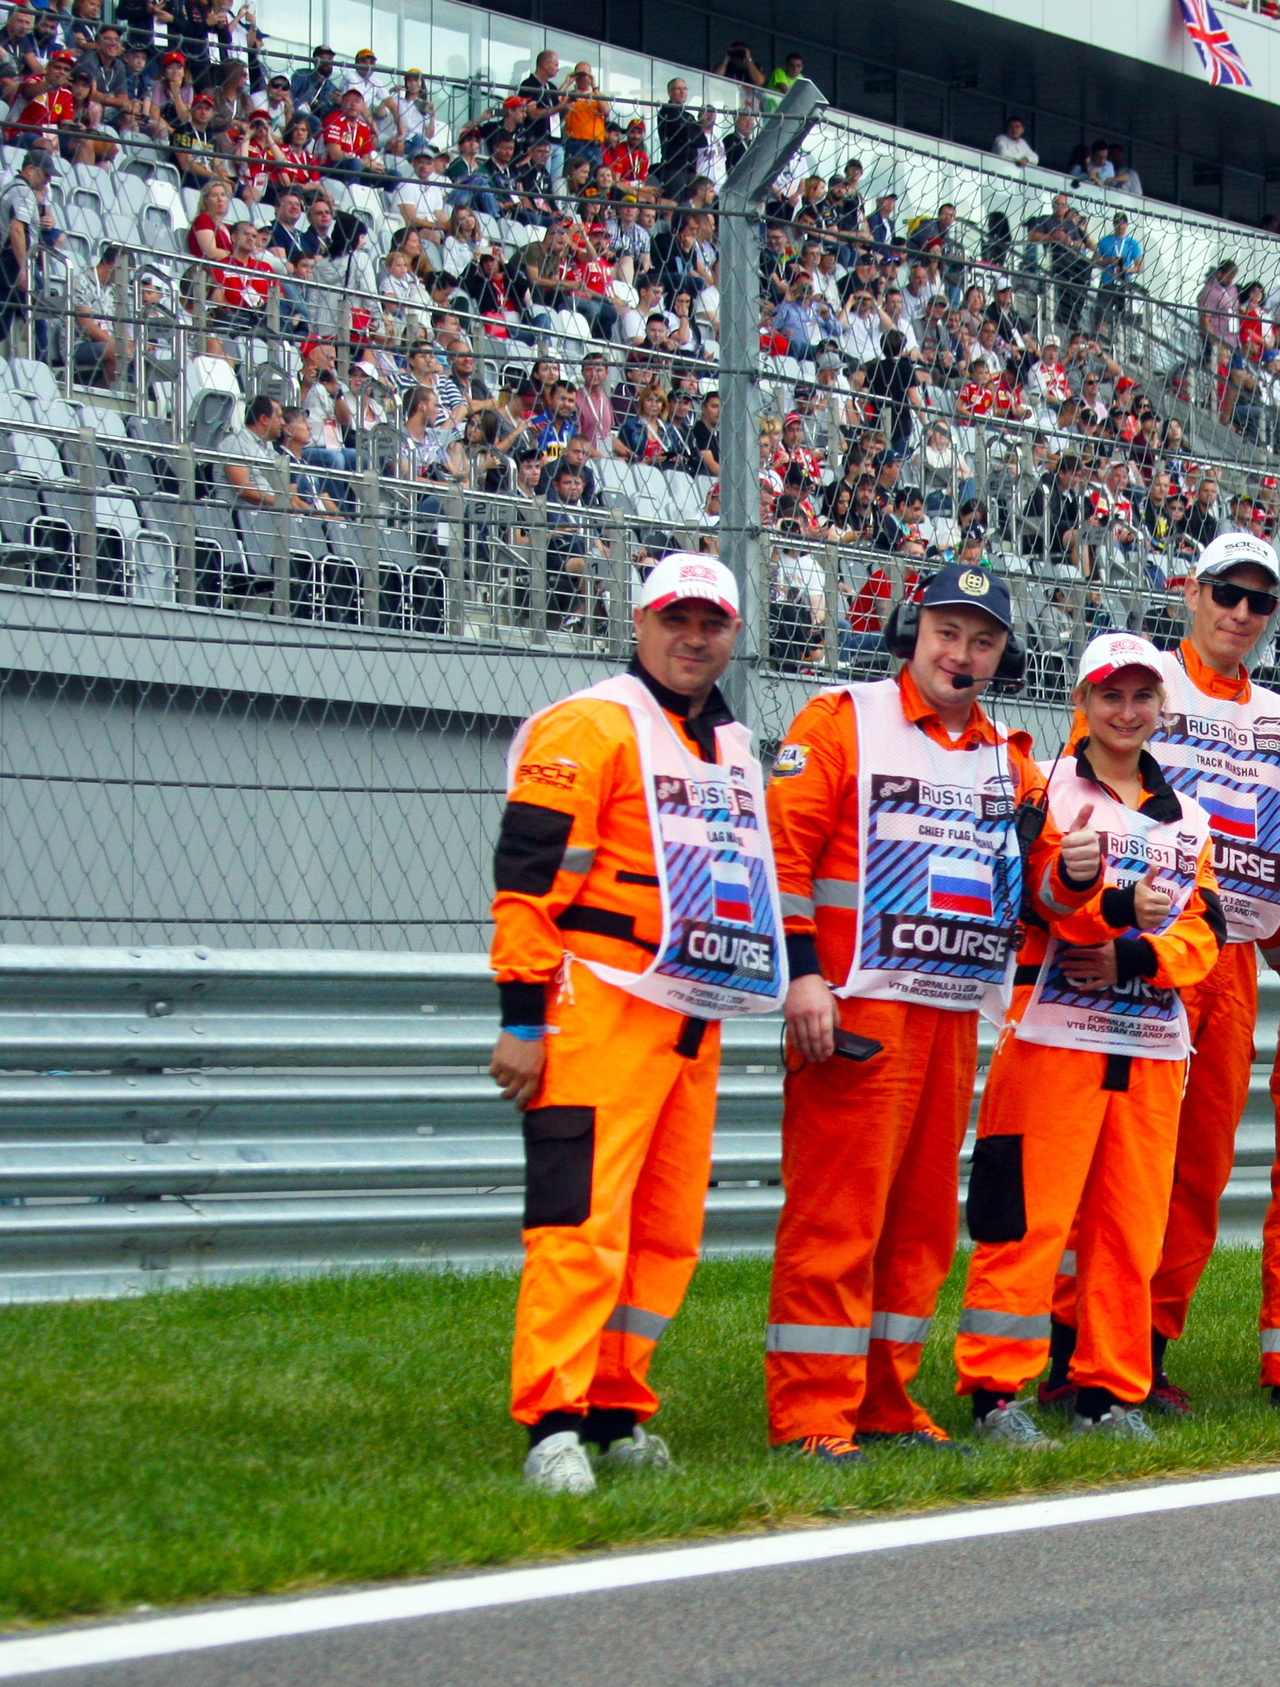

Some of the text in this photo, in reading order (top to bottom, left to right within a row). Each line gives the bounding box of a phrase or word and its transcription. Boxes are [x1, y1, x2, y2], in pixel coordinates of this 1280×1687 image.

[1196, 753, 1224, 769] TRACK
[519, 763, 577, 785] SOCHI
[918, 824, 945, 839] CHIEF
[948, 829, 971, 841] FLAG
[1110, 837, 1170, 865] RUS1631
[1213, 843, 1276, 883] URSE
[687, 929, 771, 973] COURSE
[891, 923, 1009, 963] COURSE
[888, 981, 909, 993] VTB
[908, 986, 950, 1000] RUSSIAN
[911, 978, 957, 992] FORMULA
[1066, 1020, 1086, 1031] VTB
[1086, 1023, 1128, 1036] RUSSIAN
[1128, 1029, 1163, 1039] GRAND
[1088, 1014, 1135, 1030] FORMULA
[1141, 1024, 1166, 1033] 2018
